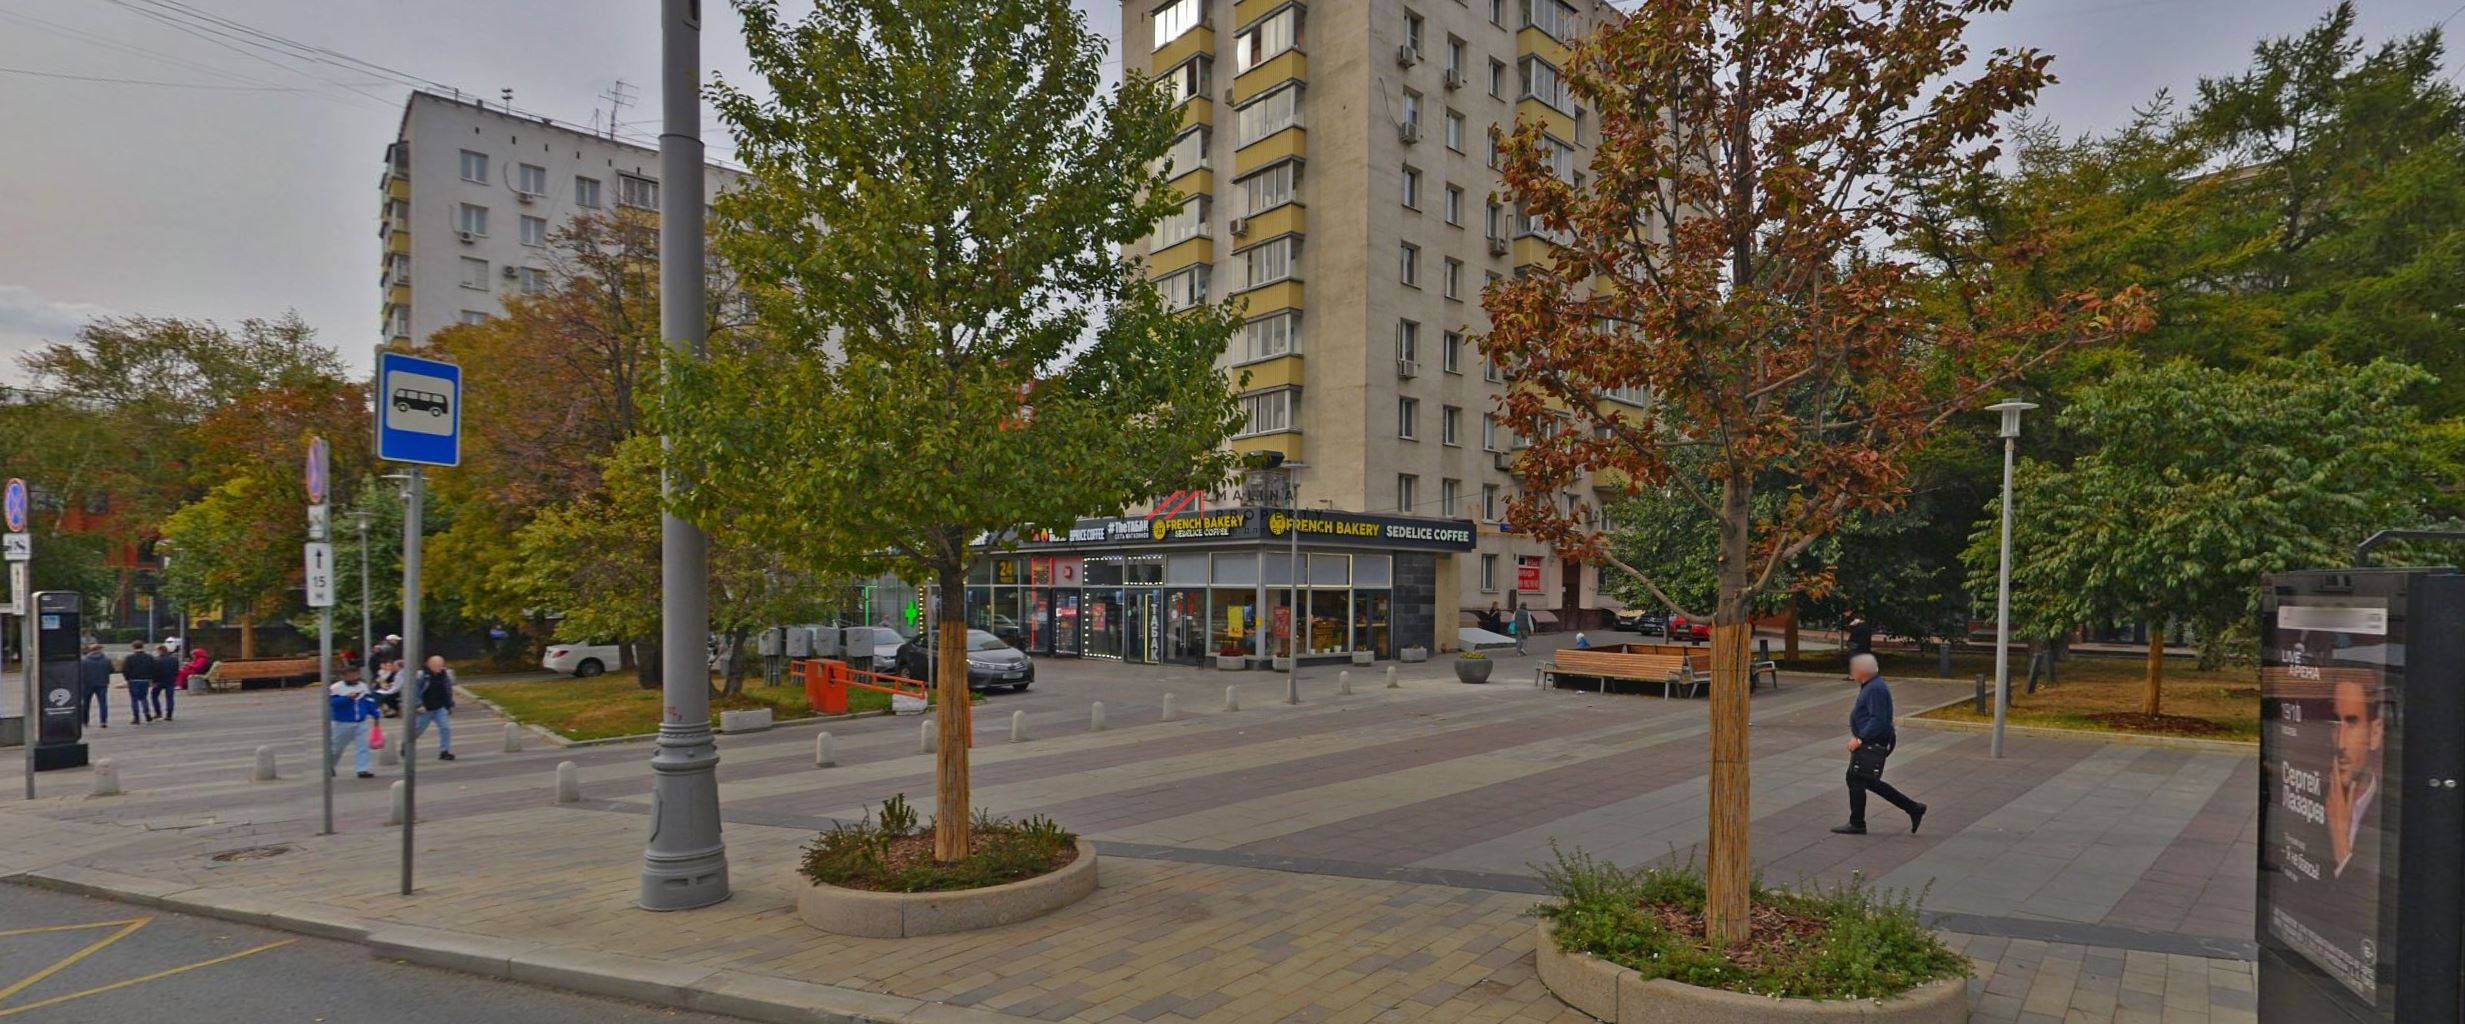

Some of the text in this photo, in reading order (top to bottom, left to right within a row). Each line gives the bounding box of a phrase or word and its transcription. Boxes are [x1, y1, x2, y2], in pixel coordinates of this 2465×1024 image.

[1166, 517, 1202, 531] FRENCH
[1203, 514, 1245, 528] BAKERY
[1286, 519, 1333, 533] FRENCH
[1336, 522, 1380, 537] BAKERY
[1386, 525, 1432, 540] SEDELICE
[1434, 528, 1470, 542] COFFEE
[999, 561, 1014, 577] 24
[313, 576, 326, 588] 15
[1150, 603, 1159, 660] ТАБАК
[2283, 760, 2320, 796] Сергей
